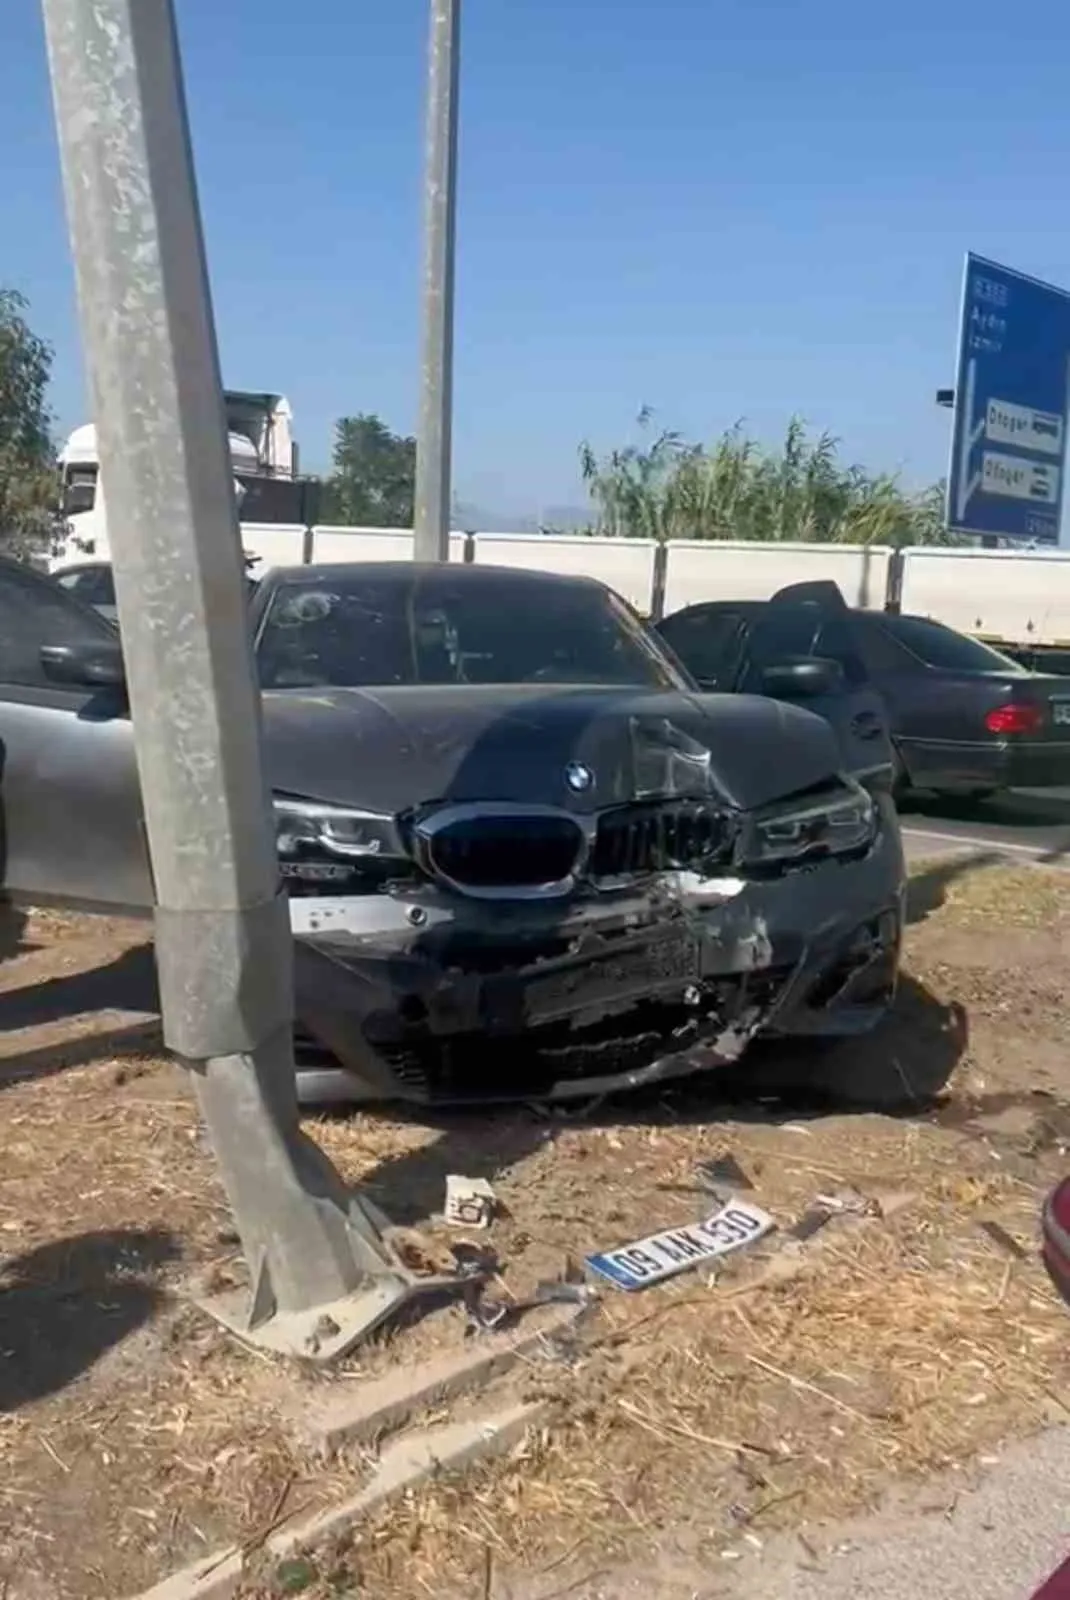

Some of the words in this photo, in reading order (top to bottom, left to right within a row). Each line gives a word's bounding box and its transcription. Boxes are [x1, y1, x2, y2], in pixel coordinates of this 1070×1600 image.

[613, 1248, 663, 1276] 09
[651, 1230, 715, 1263] AAK
[699, 1209, 761, 1244] 530
